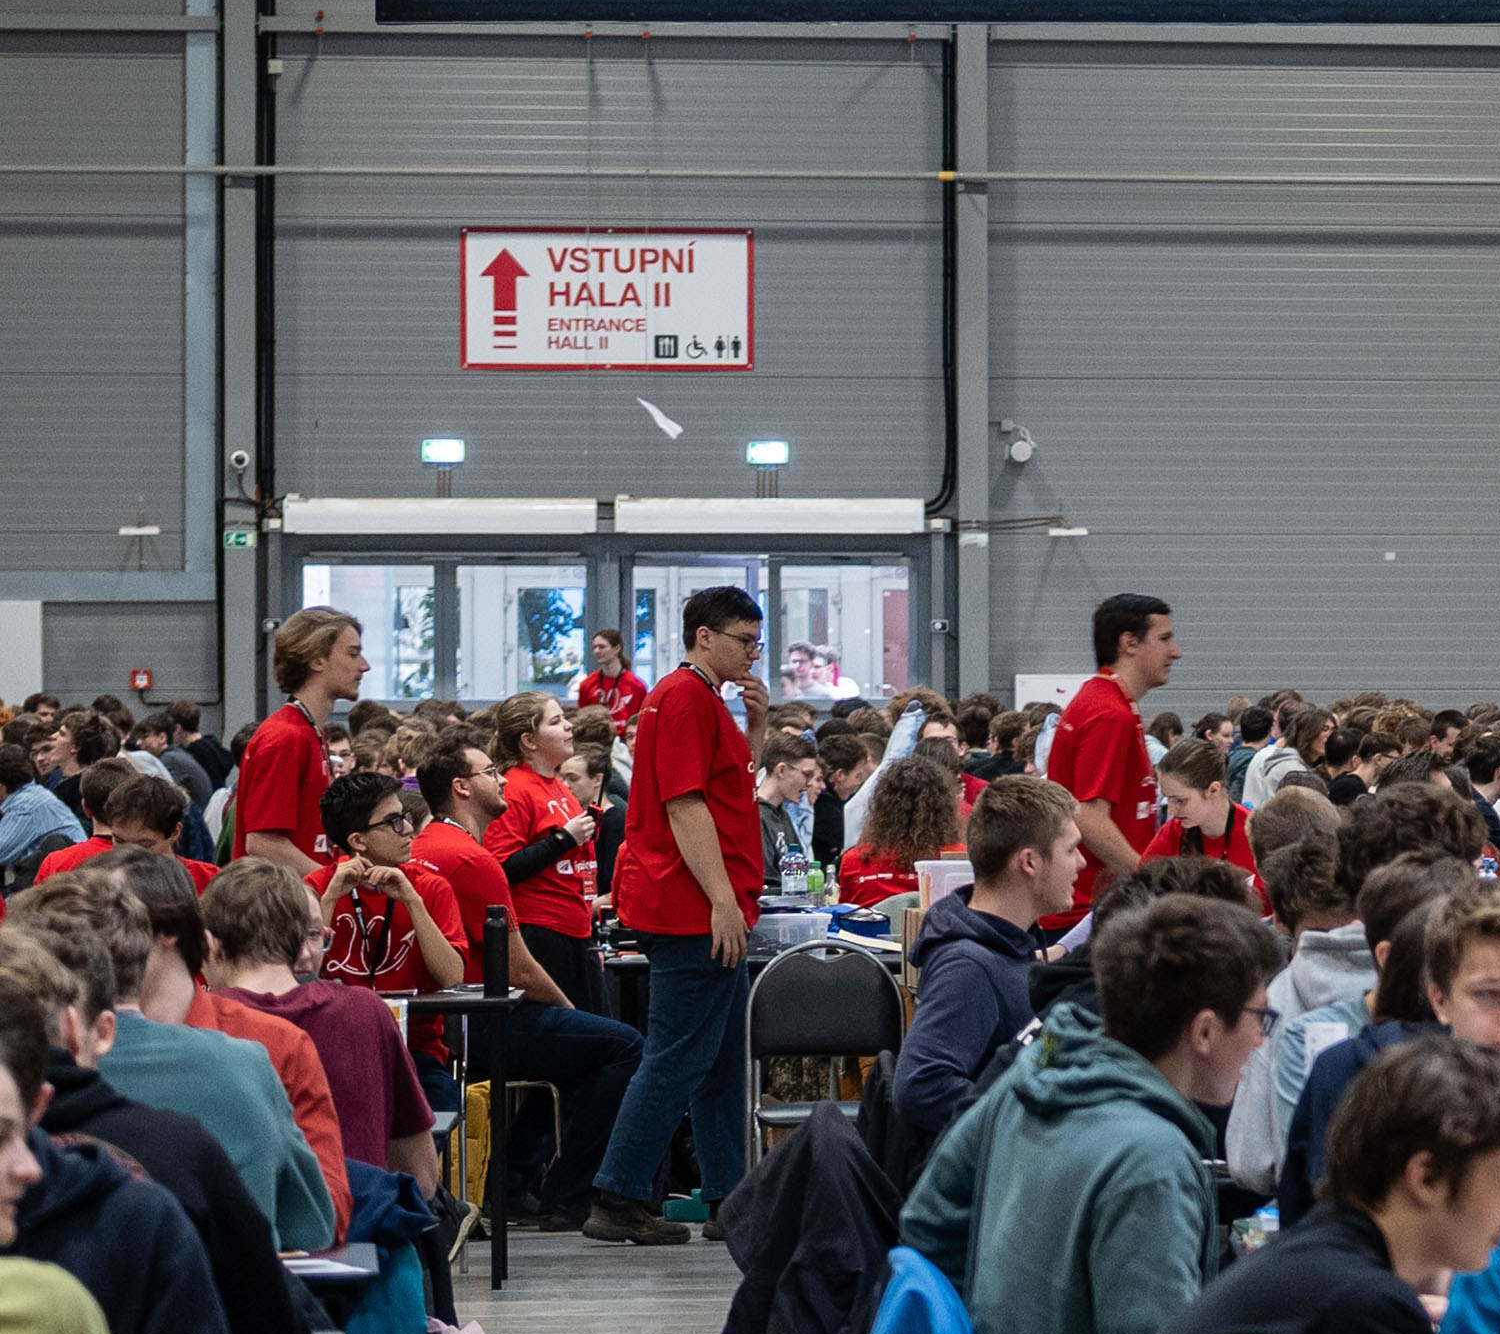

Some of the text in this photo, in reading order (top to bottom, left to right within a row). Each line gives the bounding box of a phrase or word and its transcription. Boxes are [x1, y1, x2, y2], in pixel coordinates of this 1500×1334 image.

[547, 241, 696, 274] VSTUPNÍ
[549, 282, 642, 307] HALA
[548, 318, 646, 332] ENTRANCE
[548, 336, 594, 350] HALL
